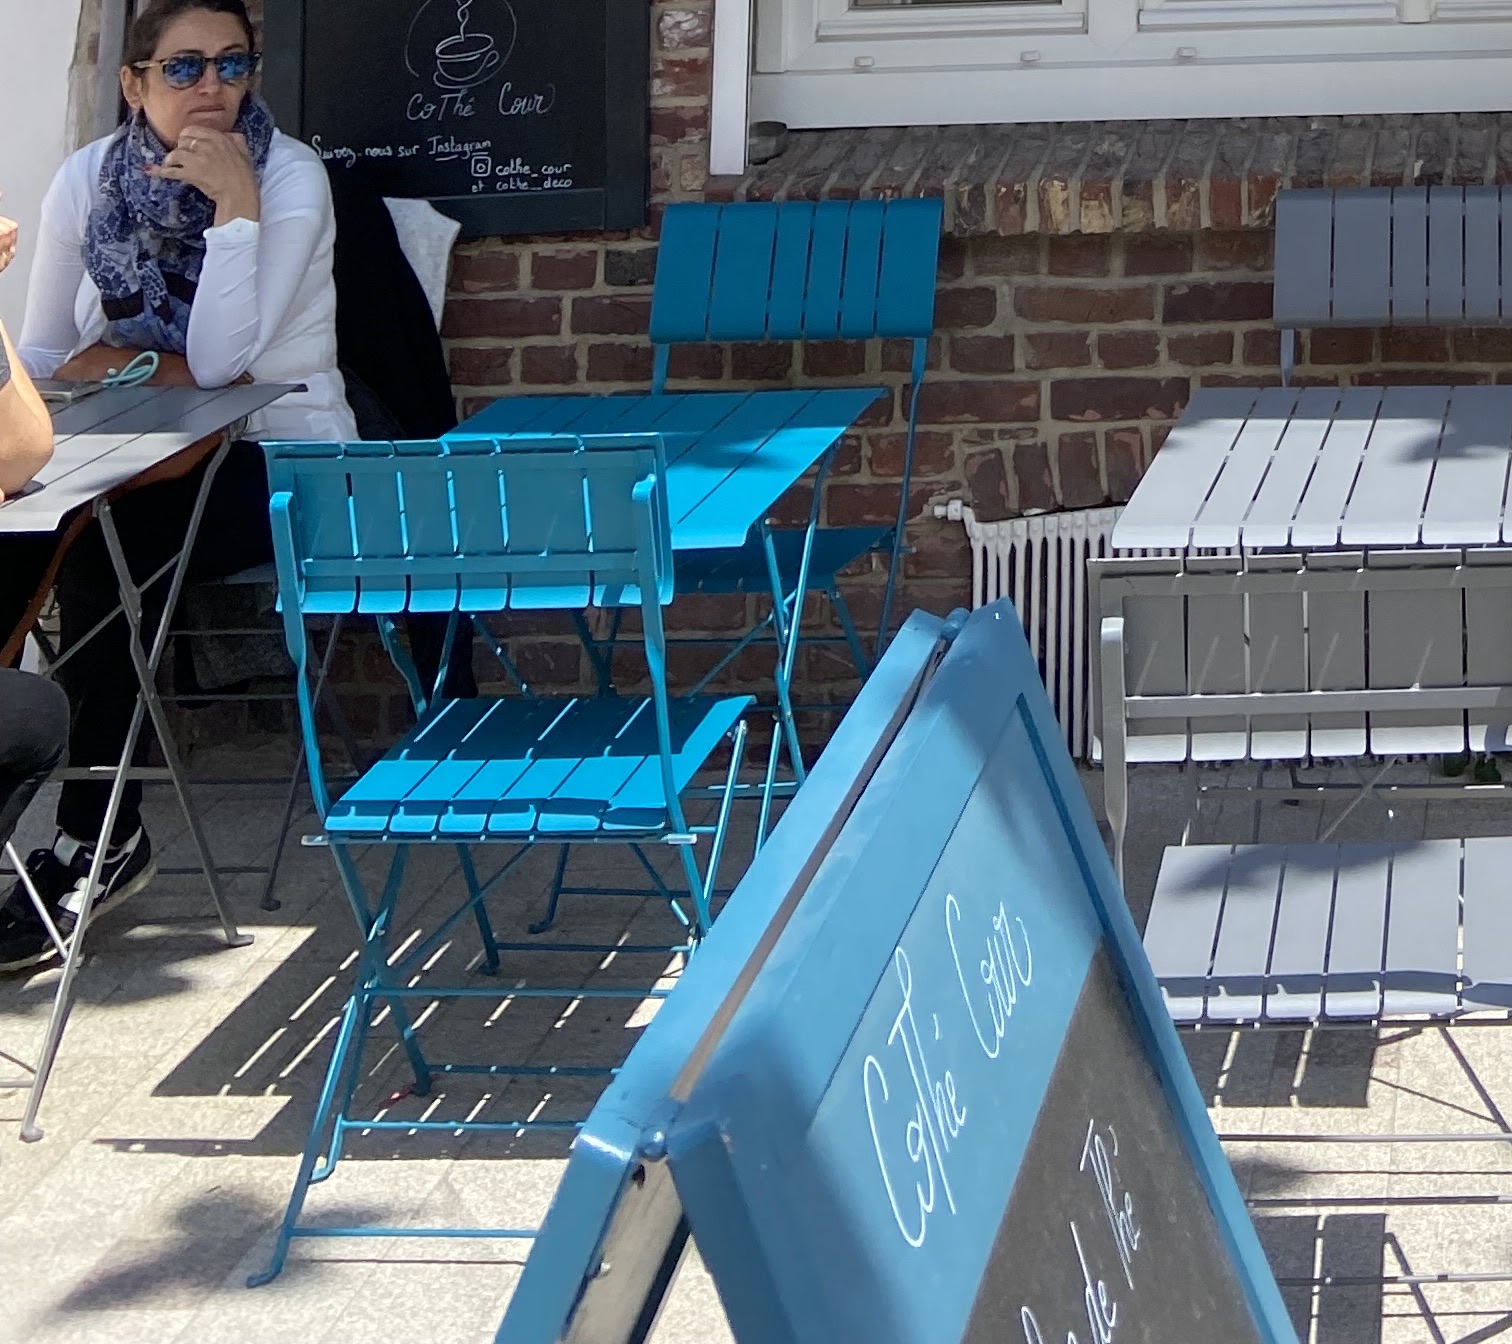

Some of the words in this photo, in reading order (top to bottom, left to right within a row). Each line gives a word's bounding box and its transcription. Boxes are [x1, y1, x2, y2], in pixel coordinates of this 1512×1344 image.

[498, 81, 556, 116] Cour
[396, 142, 420, 158] sur
[427, 135, 492, 157] Instagram
[471, 180, 485, 193] et
[945, 892, 1032, 1060] Cour
[1078, 1118, 1142, 1291] Thé
[1069, 1220, 1118, 1344] de
